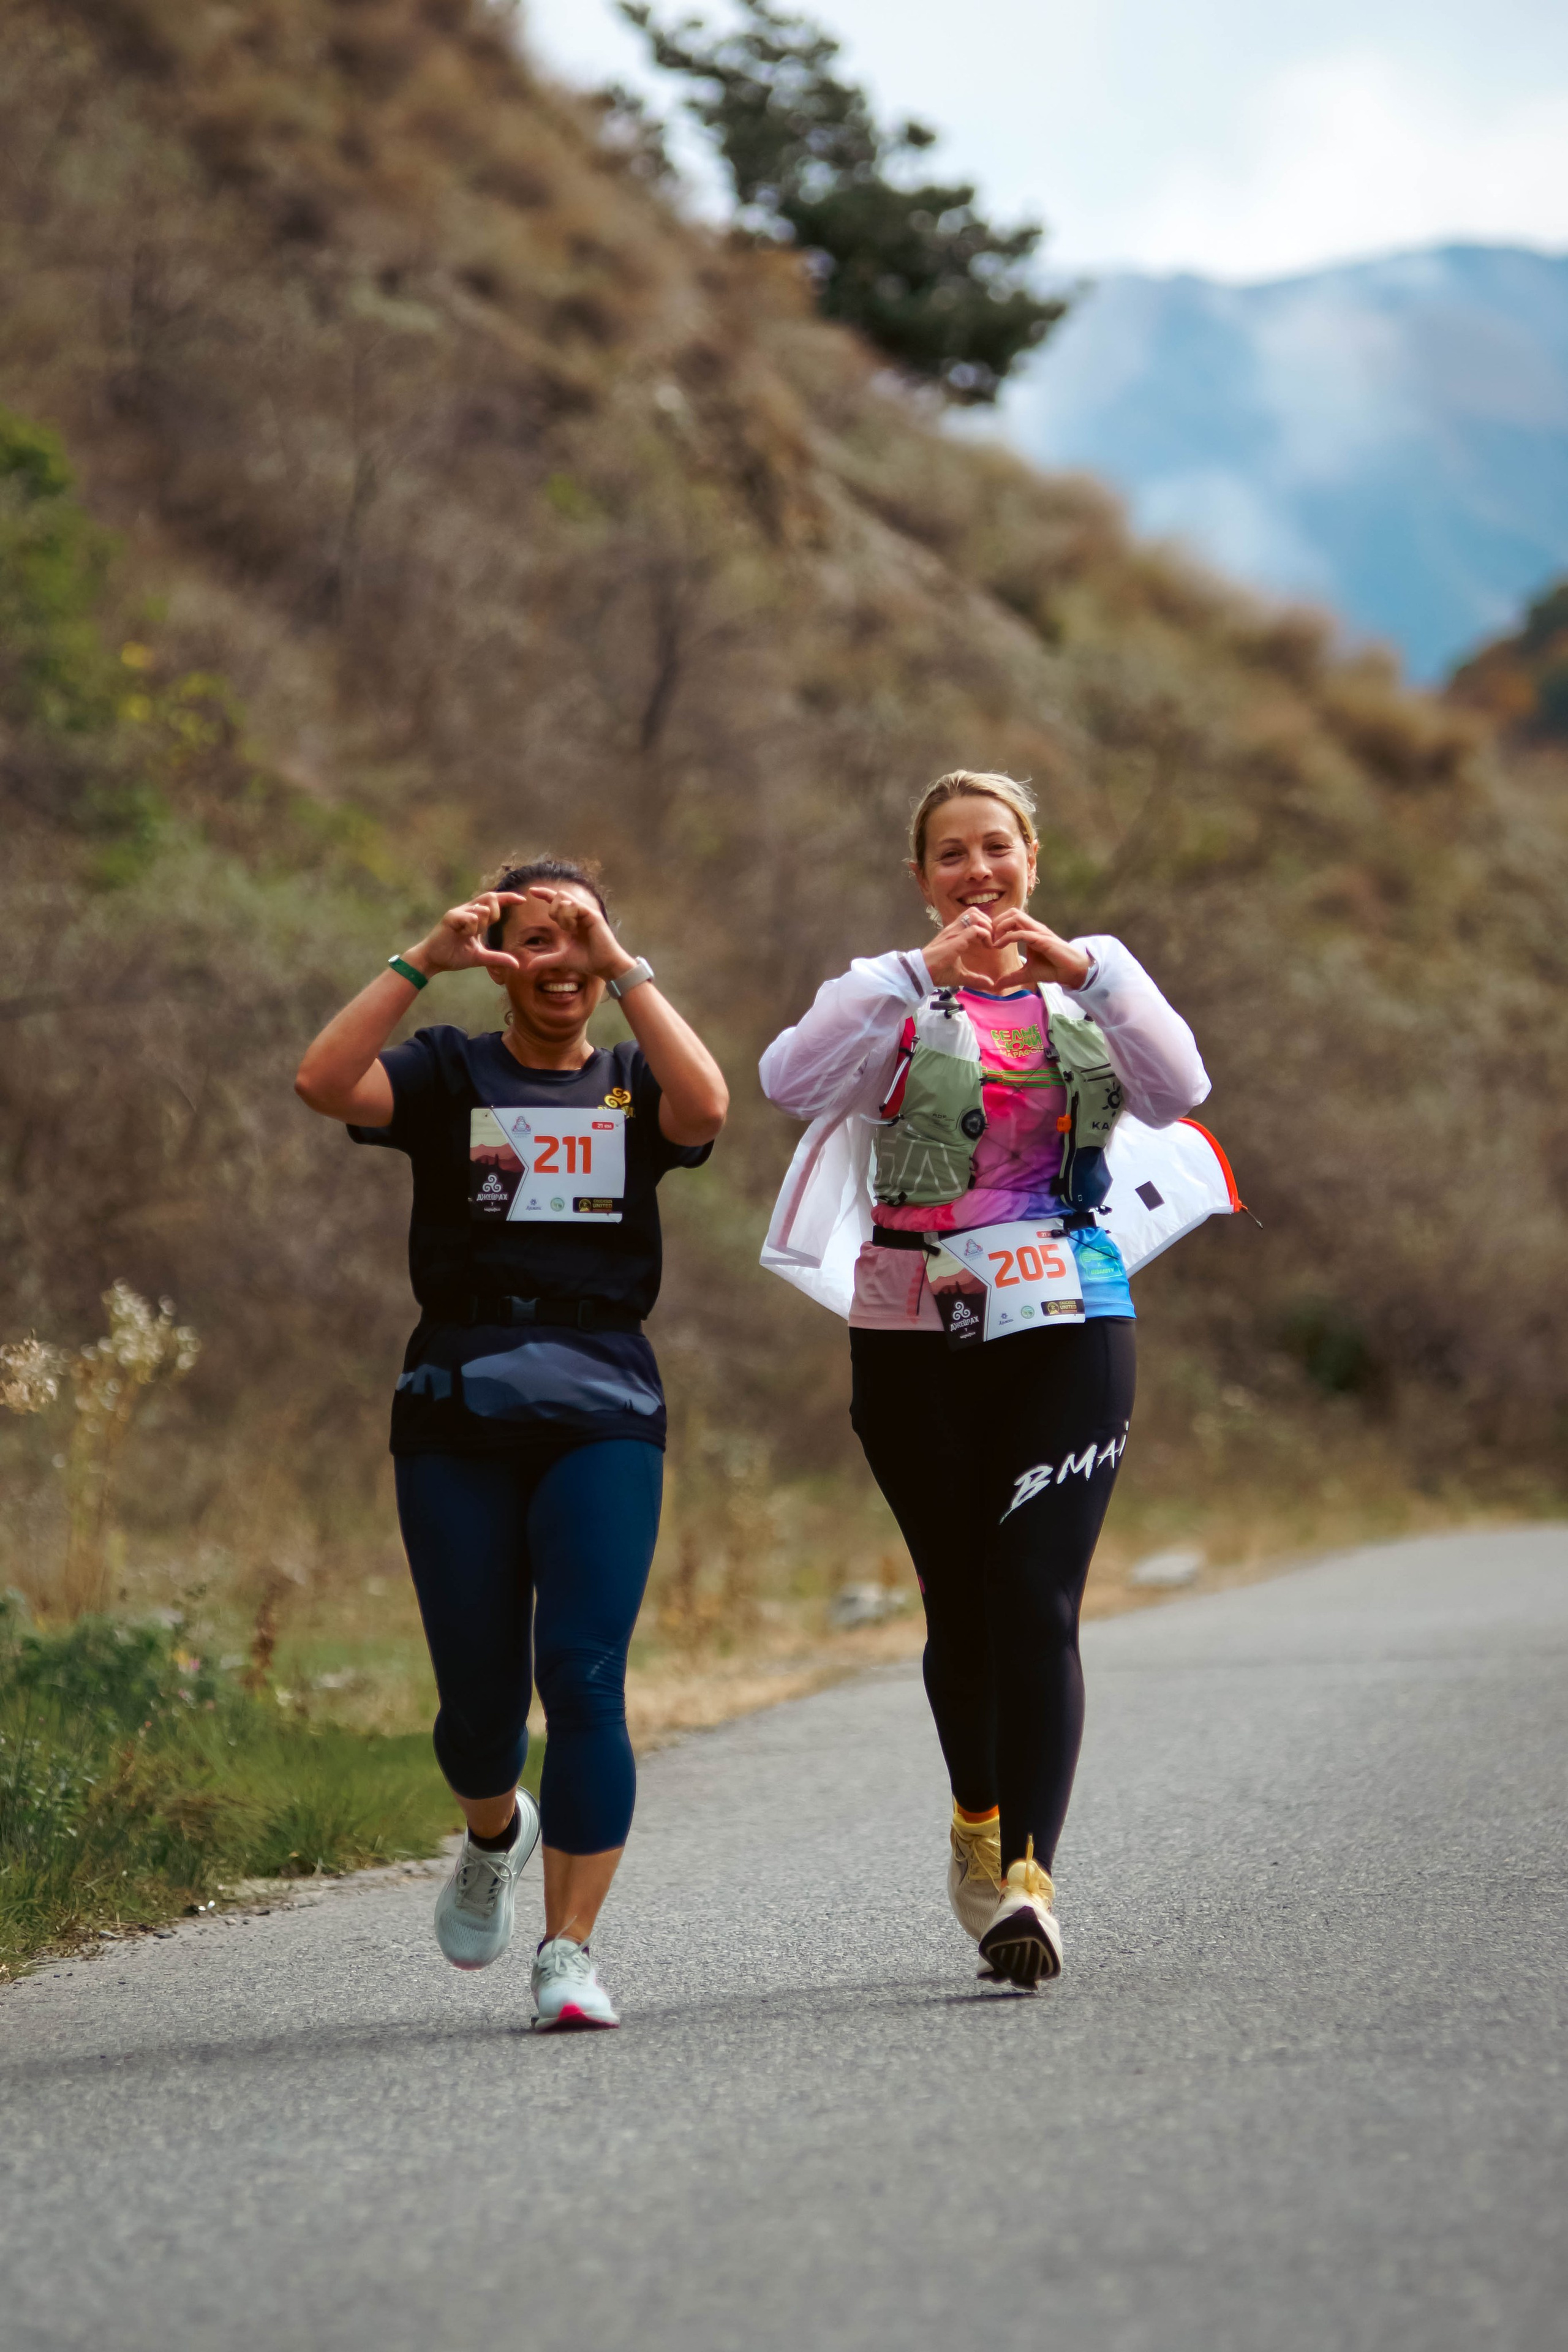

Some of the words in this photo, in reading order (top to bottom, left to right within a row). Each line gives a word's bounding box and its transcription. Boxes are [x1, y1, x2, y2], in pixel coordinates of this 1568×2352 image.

[990, 1023, 1039, 1042] БЕЛЫЕ
[533, 1135, 592, 1175] 211
[988, 1243, 1067, 1289] 205
